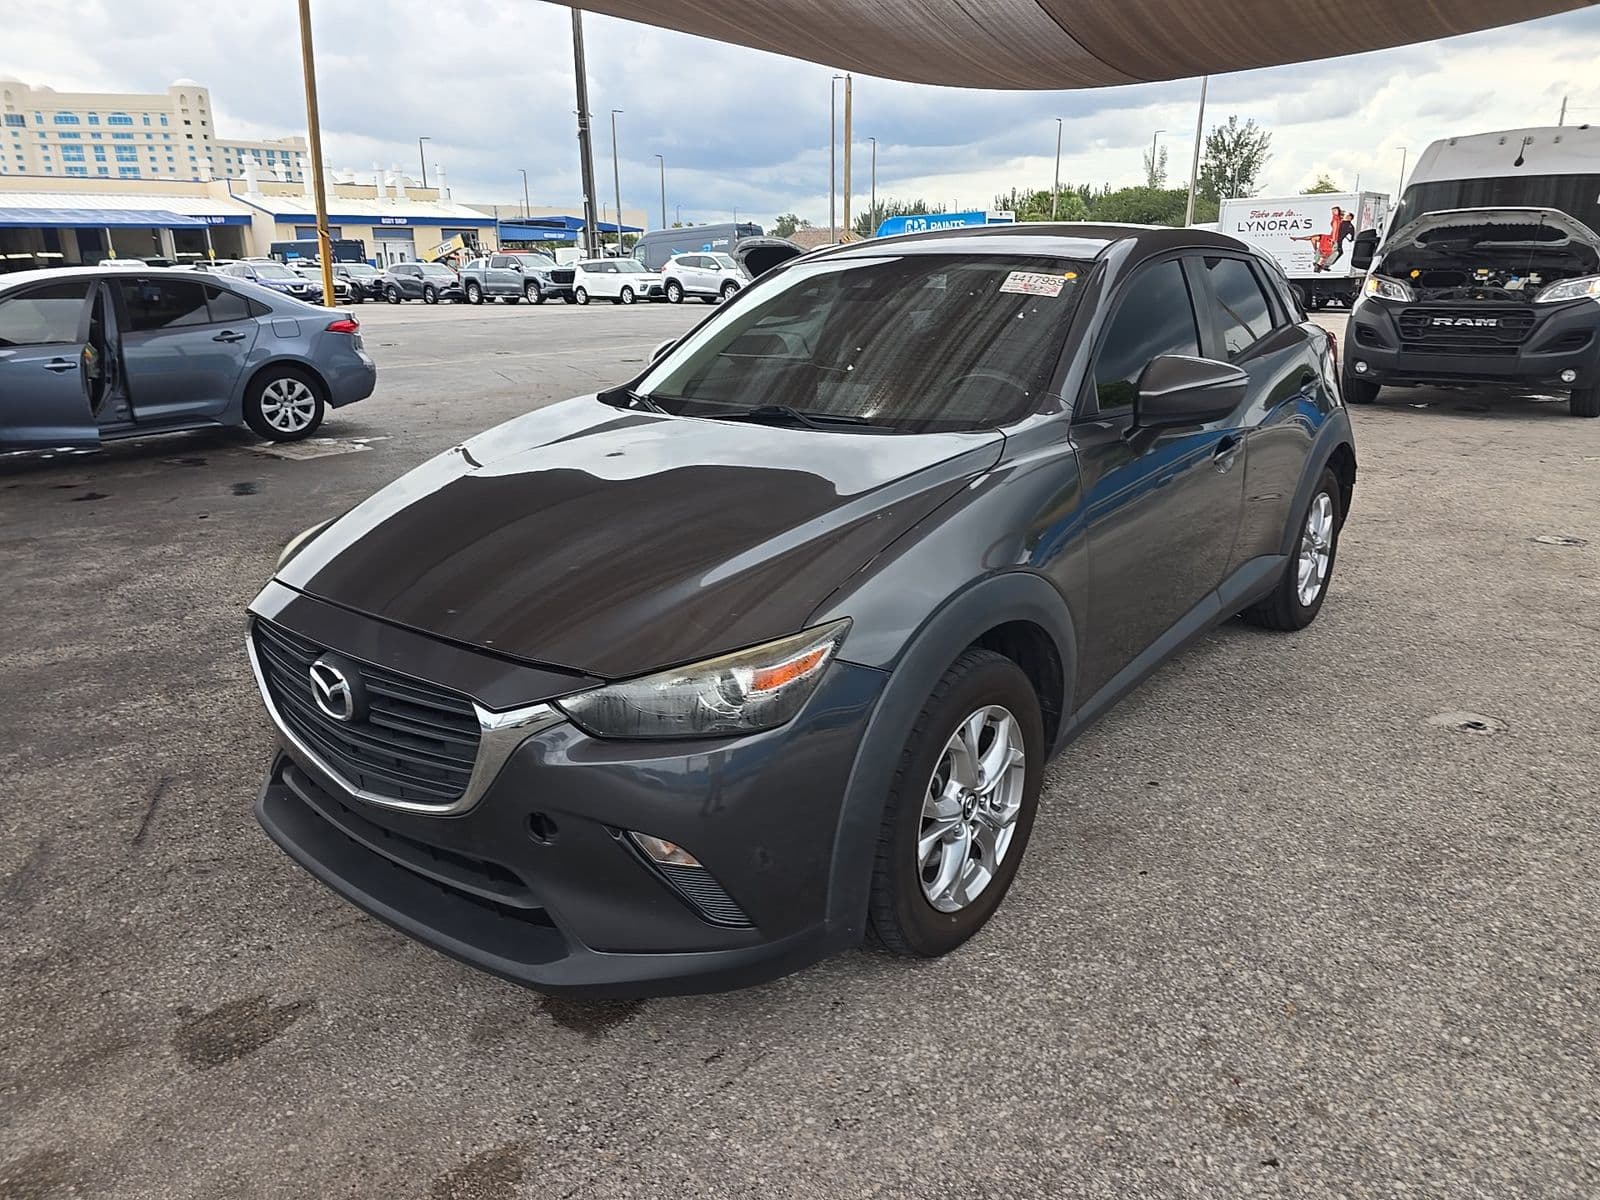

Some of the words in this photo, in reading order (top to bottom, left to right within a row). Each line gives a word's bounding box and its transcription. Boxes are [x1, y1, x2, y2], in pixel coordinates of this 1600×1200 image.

[930, 219, 965, 231] PAINTS
[1237, 218, 1313, 232] LYNORA'S
[1432, 317, 1497, 327] RAM
